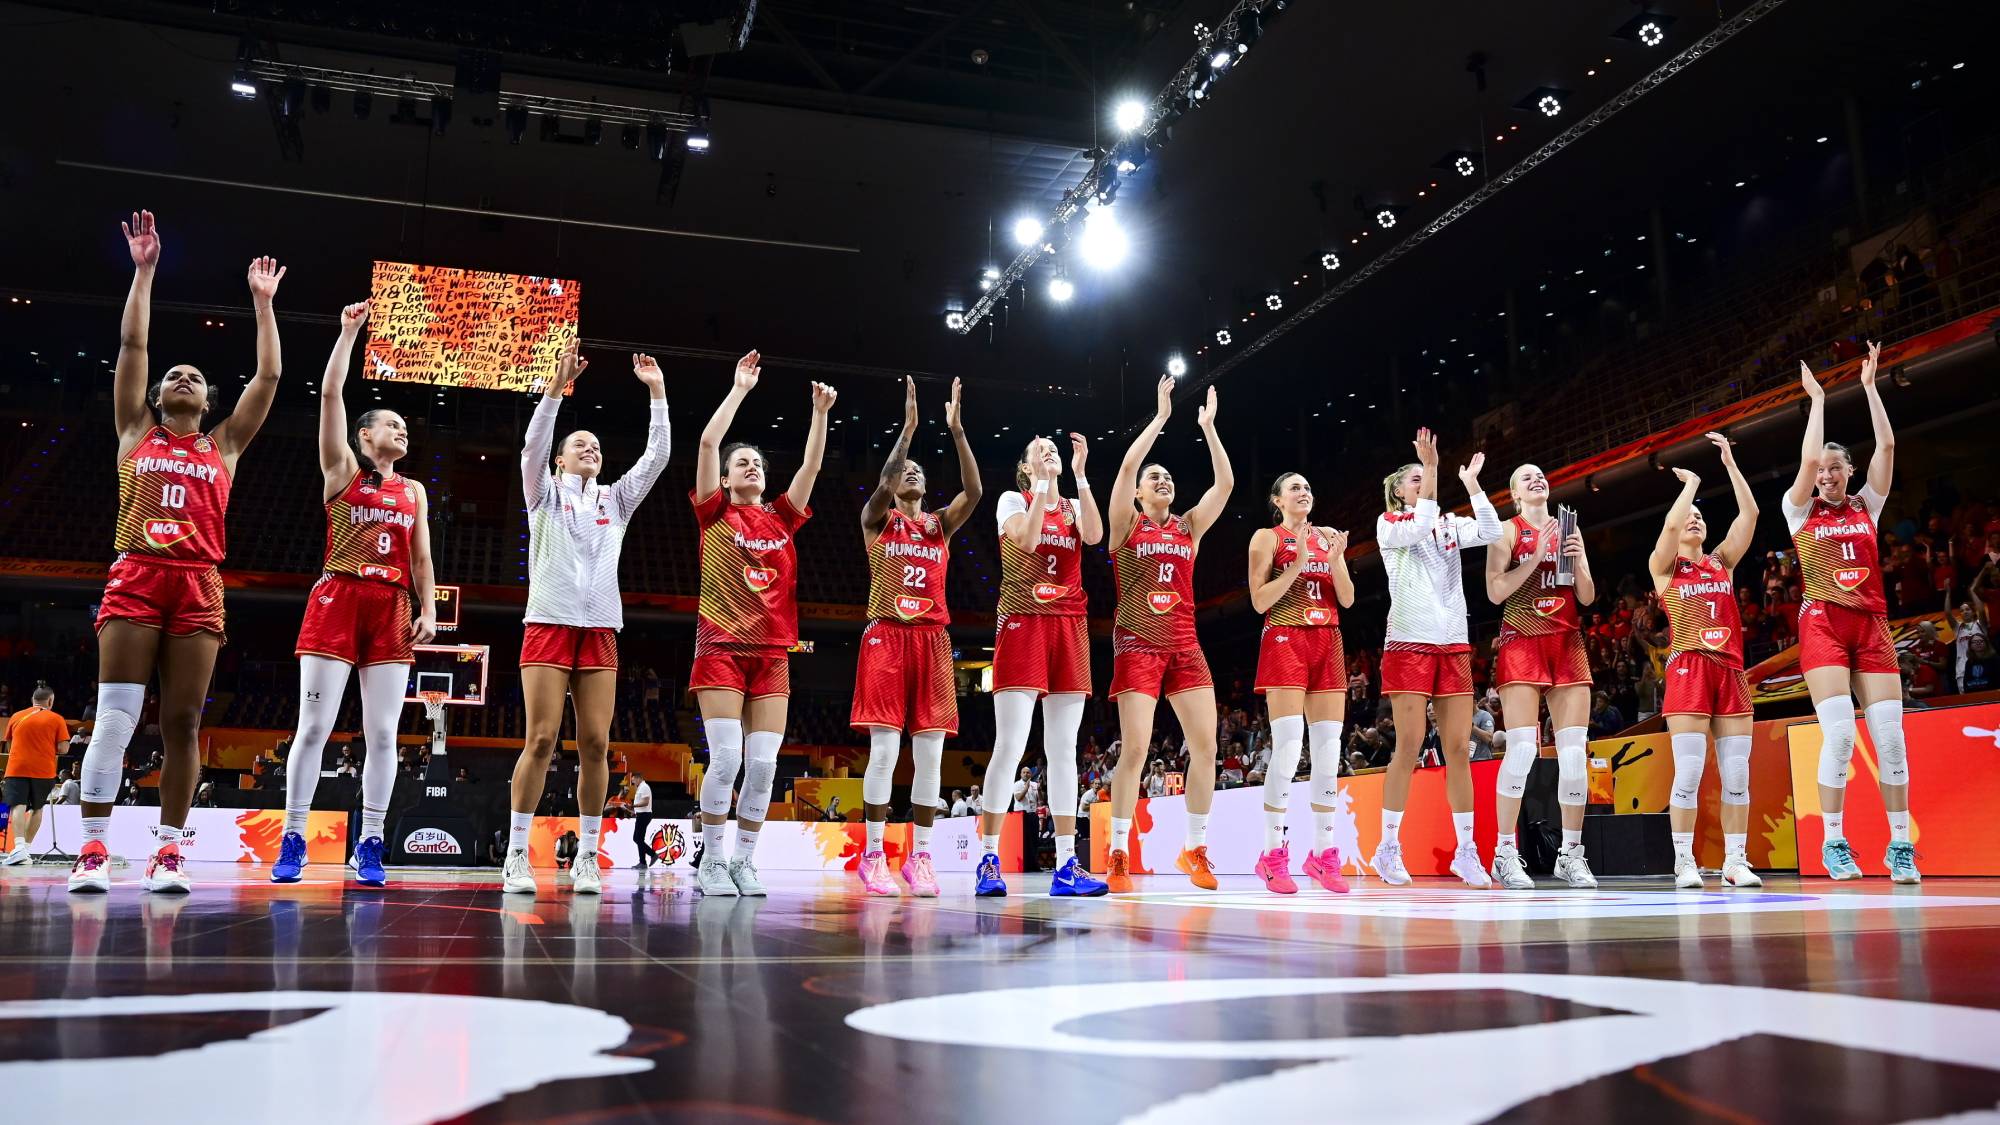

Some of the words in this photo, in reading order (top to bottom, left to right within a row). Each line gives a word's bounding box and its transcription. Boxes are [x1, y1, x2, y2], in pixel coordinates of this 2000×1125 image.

[432, 266, 459, 277] TEAM
[390, 301, 447, 314] PASSION
[388, 313, 458, 325] PRESTIGIOUS
[510, 315, 557, 331] FRAUEN
[441, 342, 500, 355] PASSION
[445, 351, 496, 364] NATIONAL
[135, 456, 218, 484] HUNGARY
[160, 483, 186, 509] 10
[150, 522, 179, 535] MOL
[1814, 521, 1871, 541] HUNGARY
[377, 532, 391, 555] 9
[1040, 533, 1076, 552] NGARY
[885, 540, 942, 564] HUNGARY
[1136, 541, 1191, 560] HUNGARY
[1840, 541, 1856, 560] 11
[1047, 554, 1057, 575] 2
[365, 566, 389, 578] MOL
[749, 569, 769, 582] MOL
[903, 565, 926, 588] 22
[1158, 562, 1175, 583] 13
[1839, 571, 1859, 580] MOL
[1540, 570, 1556, 589] 14
[1037, 586, 1057, 595] MOL
[1306, 580, 1322, 600] 21
[1679, 580, 1731, 600] HUNGARY
[900, 598, 920, 610] MOL
[1153, 594, 1171, 604] MOL
[1537, 599, 1555, 608] MOL
[1309, 610, 1324, 619] MOL
[1706, 601, 1716, 619] 7
[1705, 630, 1723, 640] MOL
[426, 786, 447, 797] FIBA
[182, 830, 196, 839] UP
[414, 831, 447, 841] 百岁山
[180, 839, 195, 847] 026
